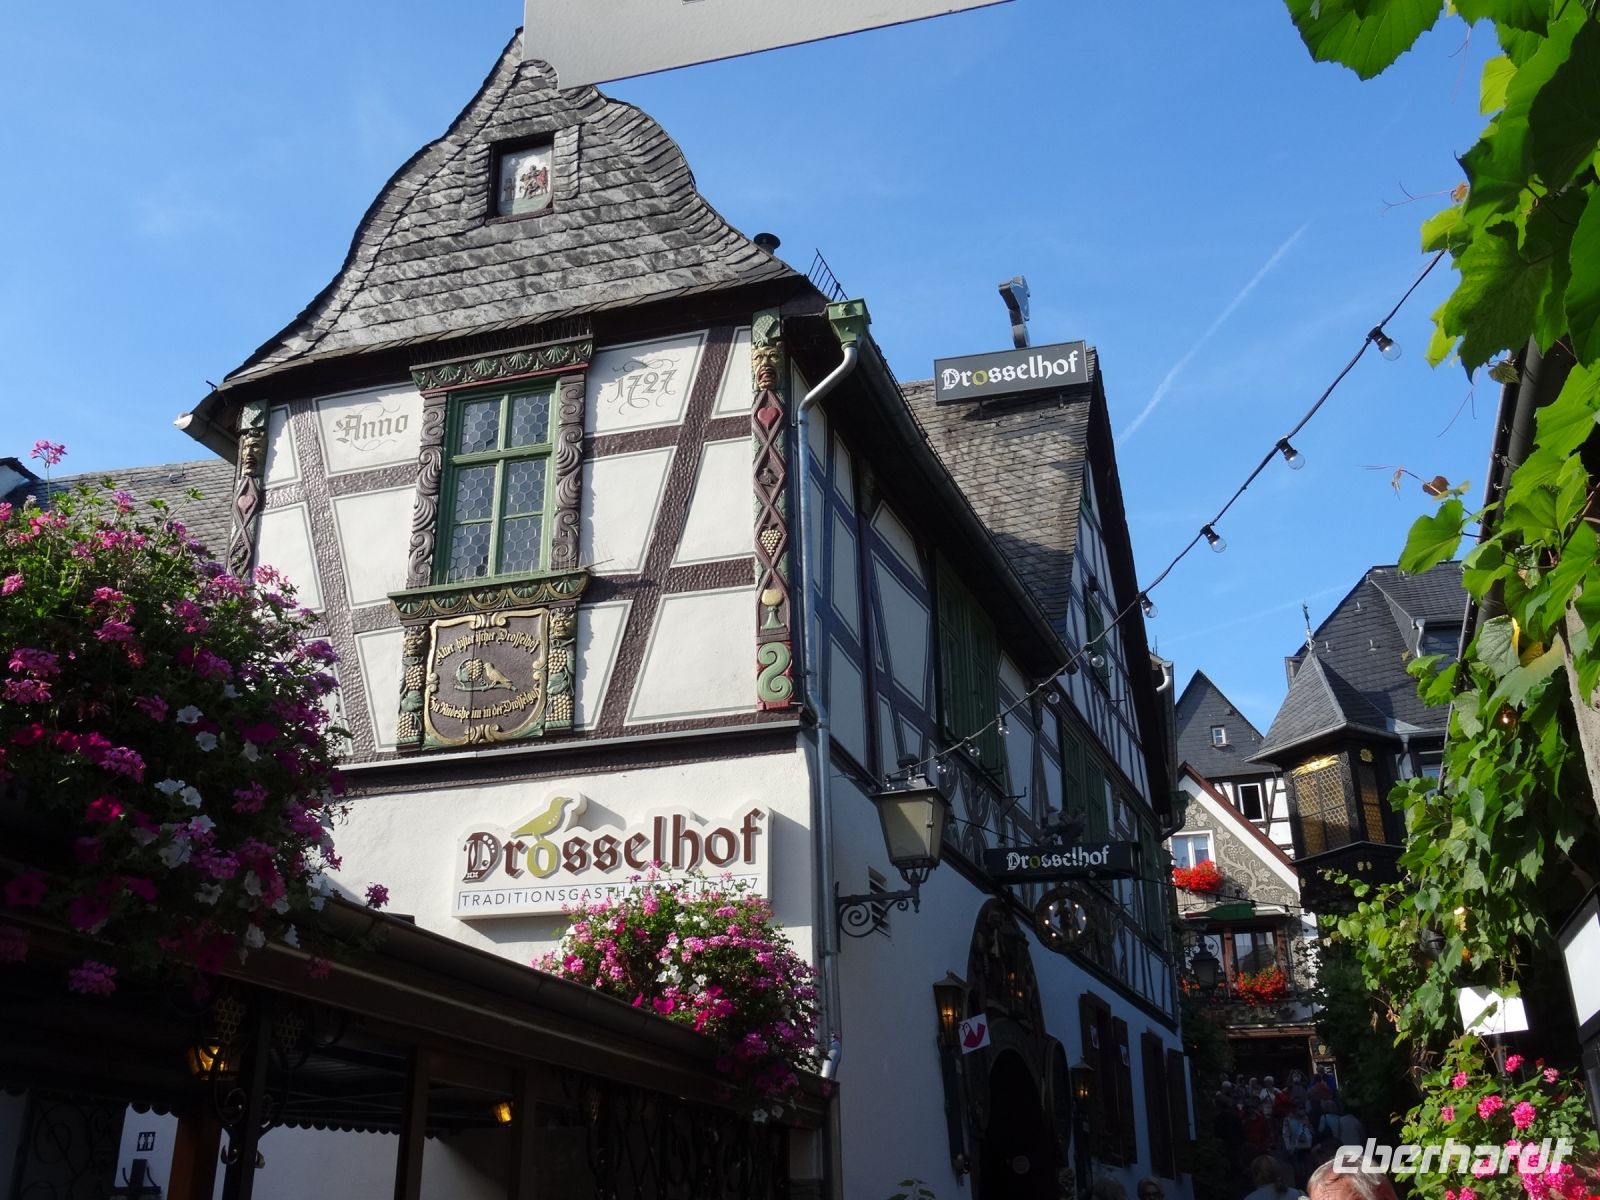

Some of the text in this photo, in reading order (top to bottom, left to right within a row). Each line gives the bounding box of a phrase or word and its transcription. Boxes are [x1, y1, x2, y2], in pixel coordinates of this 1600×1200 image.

[606, 369, 678, 409] 1727
[941, 349, 1079, 391] Drosselhof
[333, 414, 409, 444] Anno
[463, 807, 765, 882] Drosselhof
[1006, 844, 1110, 871] Drosselhof
